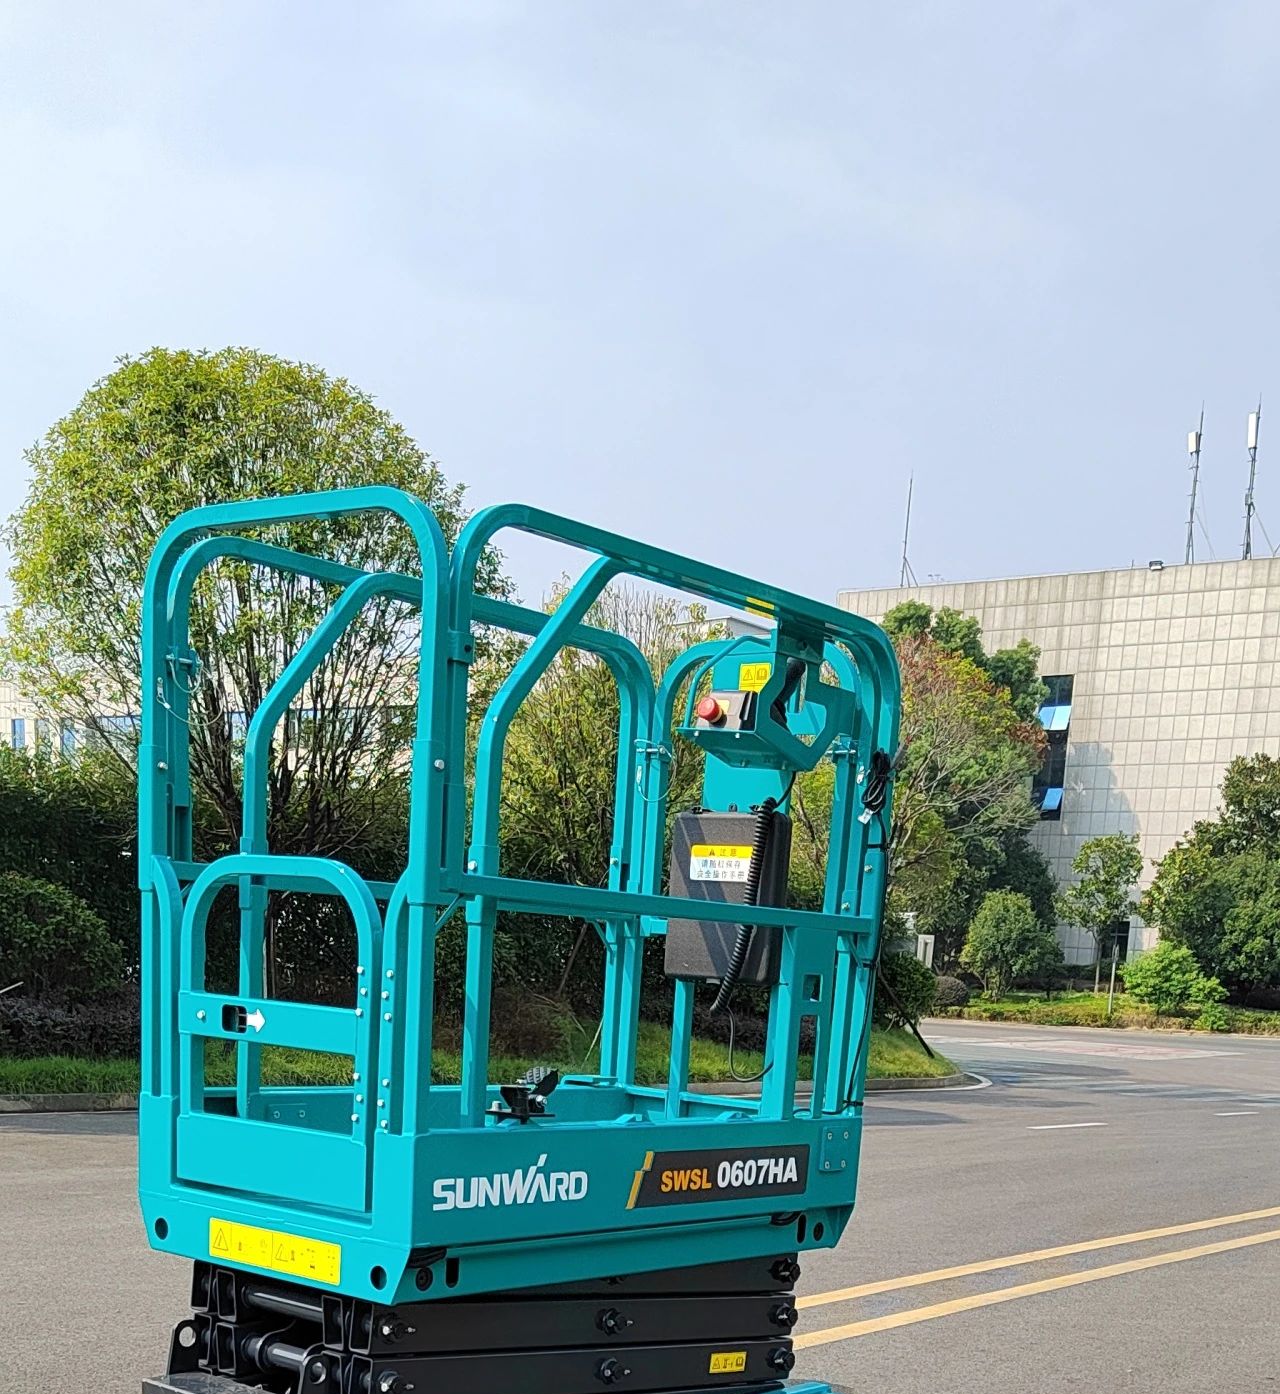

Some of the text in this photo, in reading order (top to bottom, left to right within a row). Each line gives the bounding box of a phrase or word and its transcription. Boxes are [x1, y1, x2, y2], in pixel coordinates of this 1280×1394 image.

[432, 1153, 588, 1211] SUNWARD
[660, 1157, 798, 1193] SWSL 0607HA
